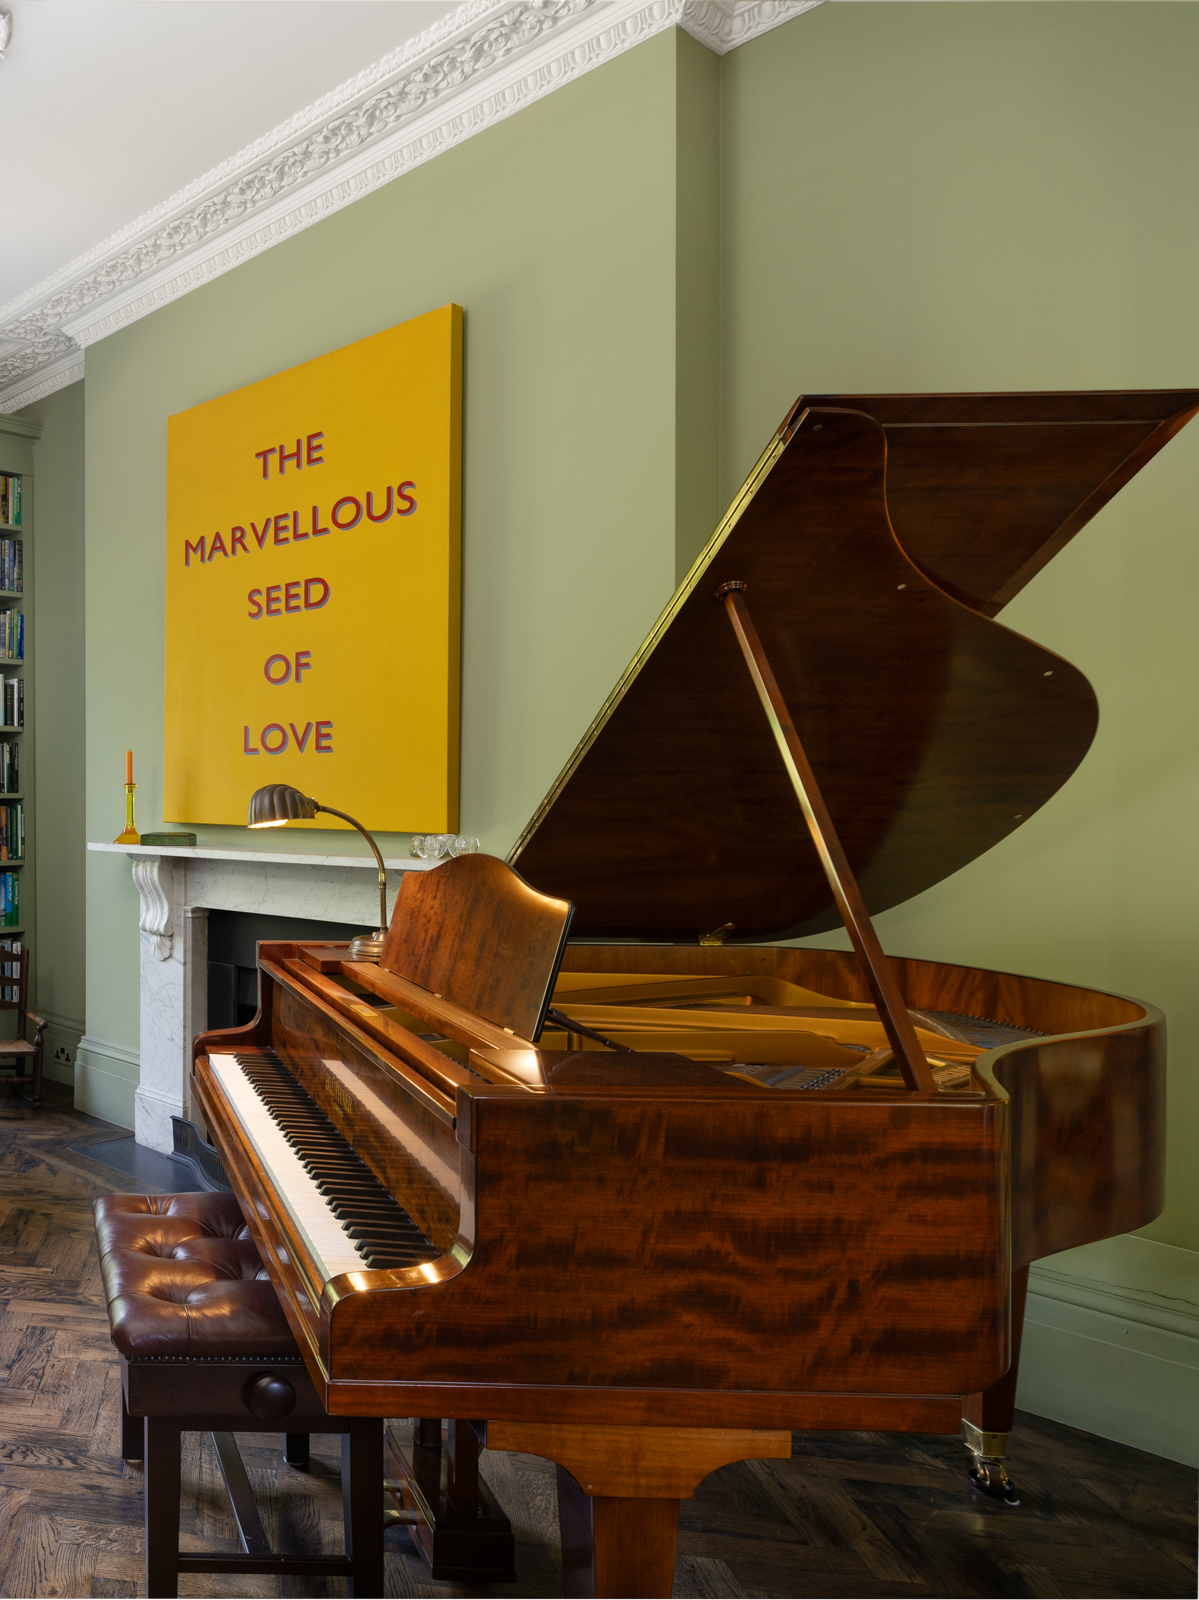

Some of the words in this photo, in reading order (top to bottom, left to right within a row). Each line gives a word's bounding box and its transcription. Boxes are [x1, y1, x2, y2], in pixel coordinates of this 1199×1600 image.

[255, 431, 325, 480] THE
[184, 480, 417, 568] MARVELLOUS
[247, 577, 331, 620] SEED
[263, 650, 312, 685] OF
[243, 720, 333, 755] LOVE
